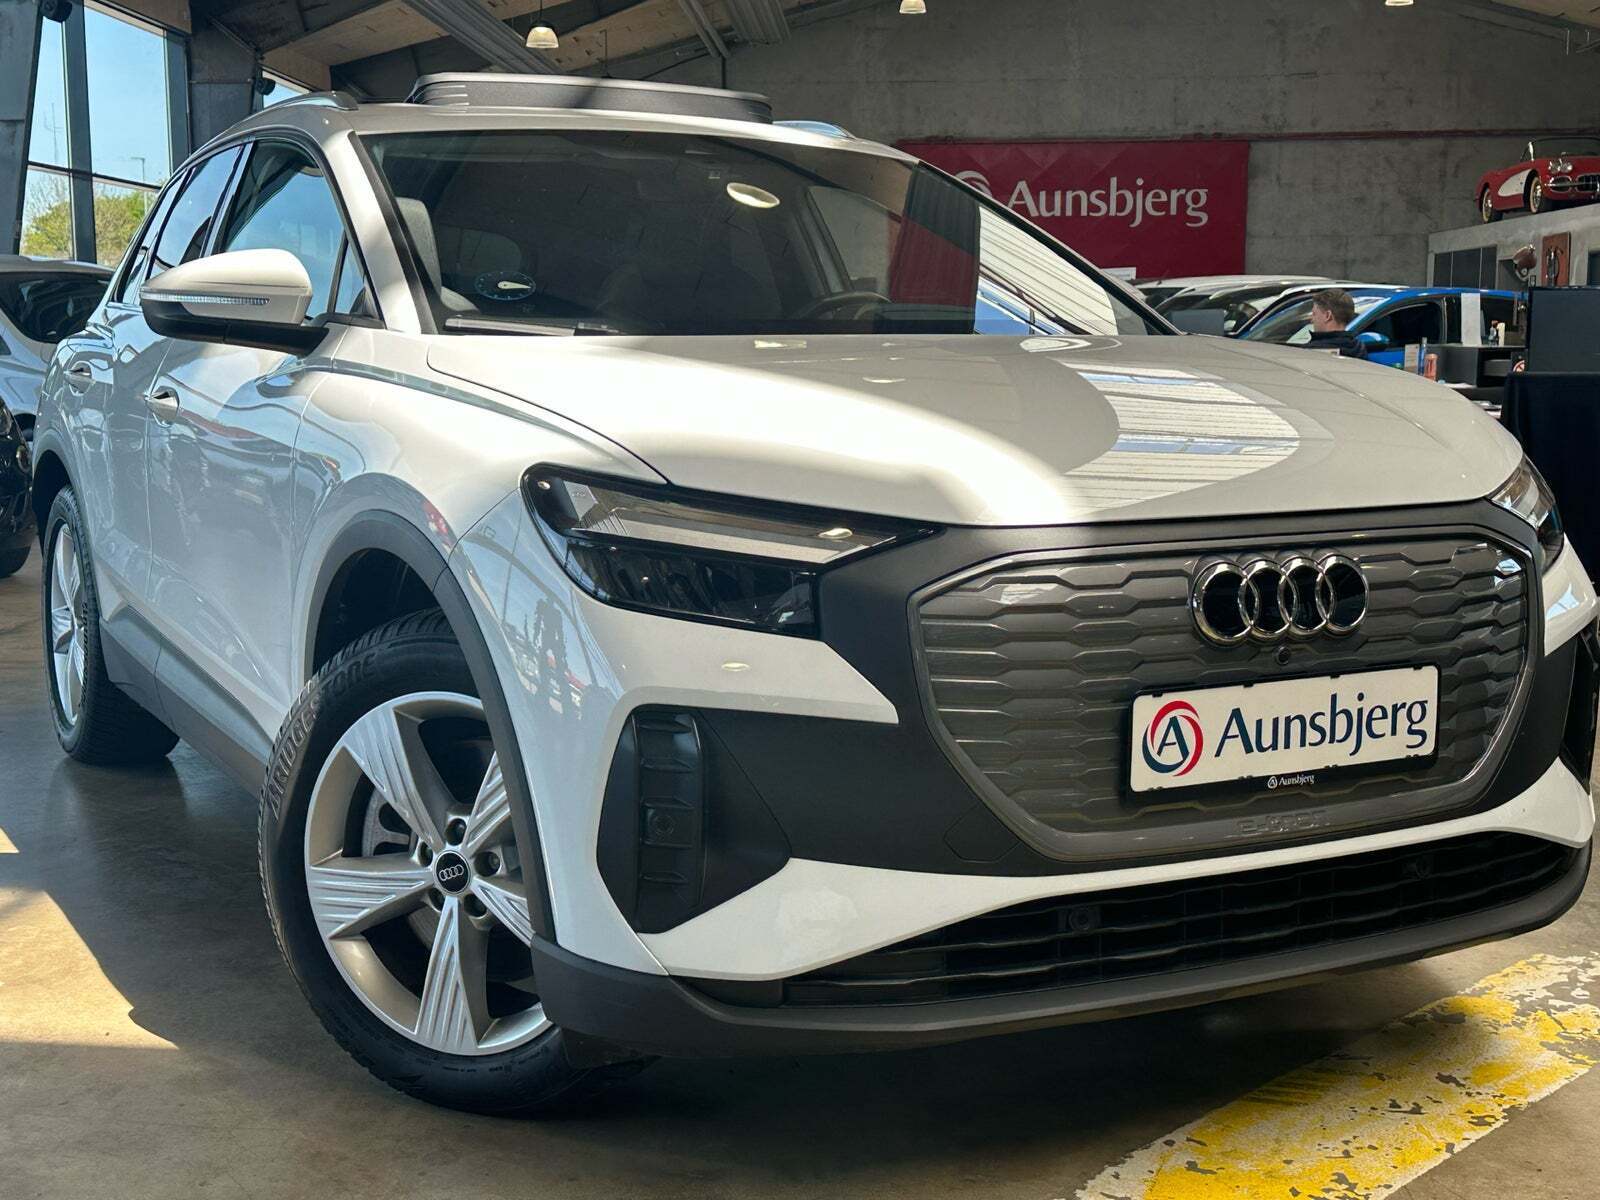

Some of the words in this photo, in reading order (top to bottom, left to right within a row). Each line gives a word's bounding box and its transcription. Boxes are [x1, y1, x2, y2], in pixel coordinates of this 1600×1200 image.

[1006, 177, 1208, 227] Aunsbjerg
[1214, 693, 1428, 758] Aunsbjerg
[1279, 775, 1315, 786] Aunsbjerg
